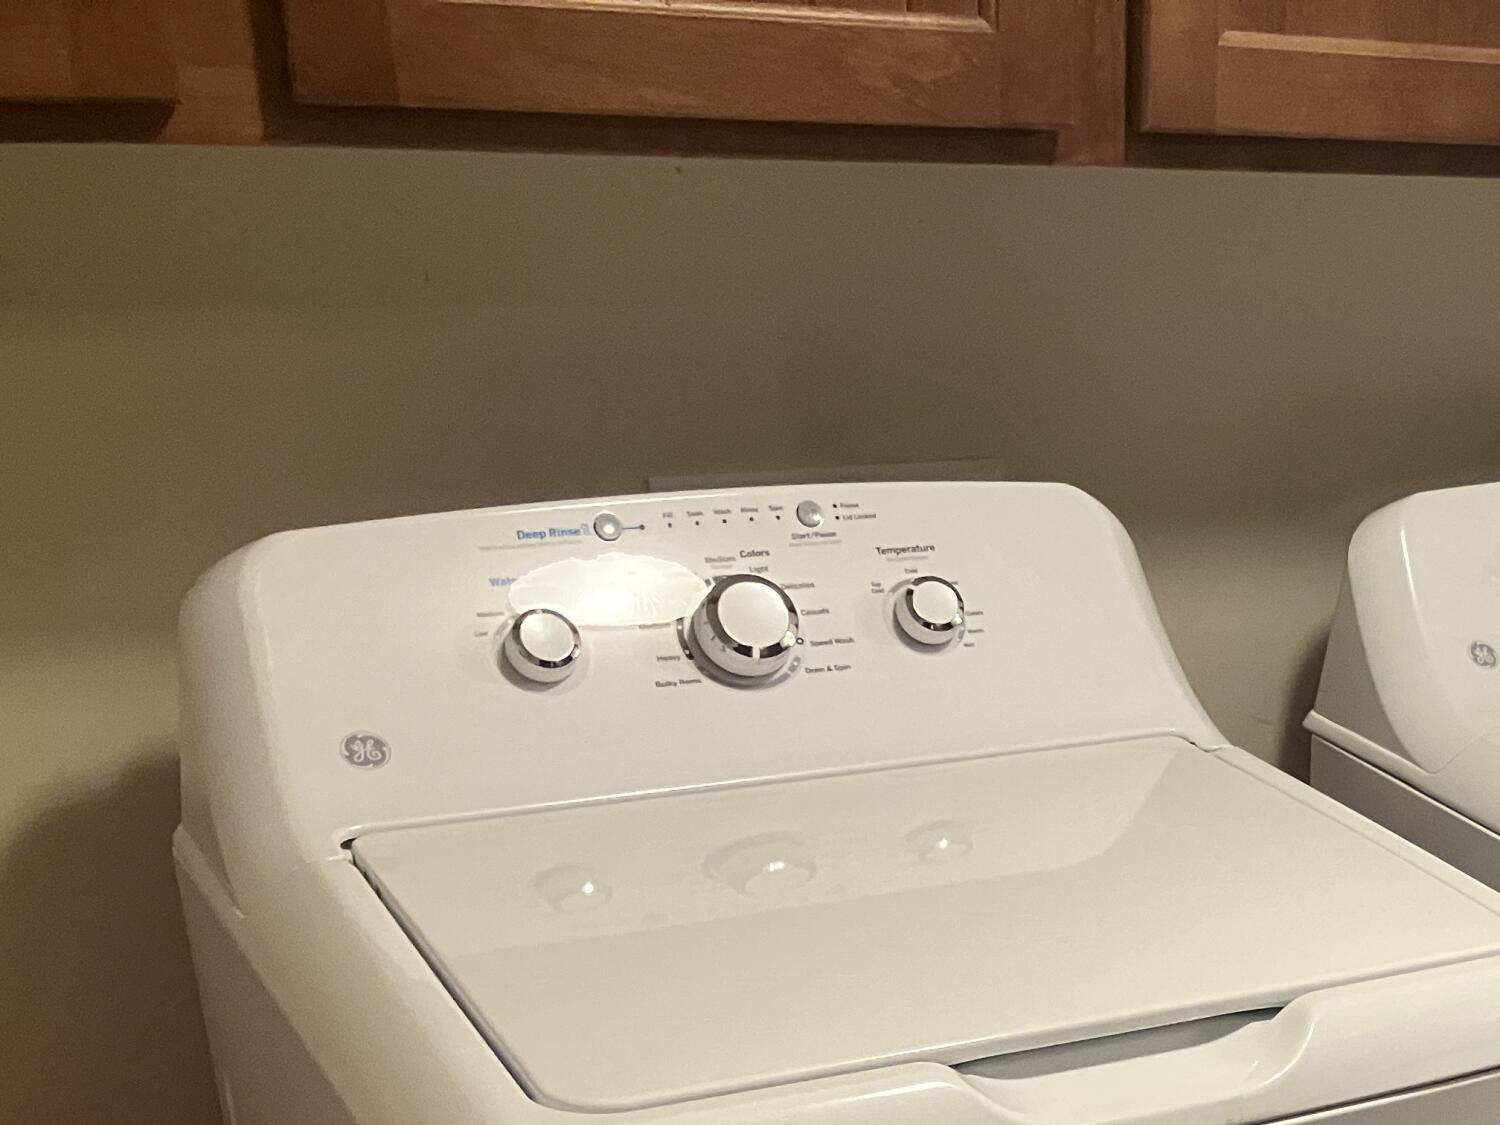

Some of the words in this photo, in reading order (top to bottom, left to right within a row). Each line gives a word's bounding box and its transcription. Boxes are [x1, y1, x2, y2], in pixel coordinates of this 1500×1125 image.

[516, 530, 547, 541] Deep
[549, 528, 581, 538] Rinse
[739, 550, 770, 558] Colors
[875, 544, 936, 555] Temperature
